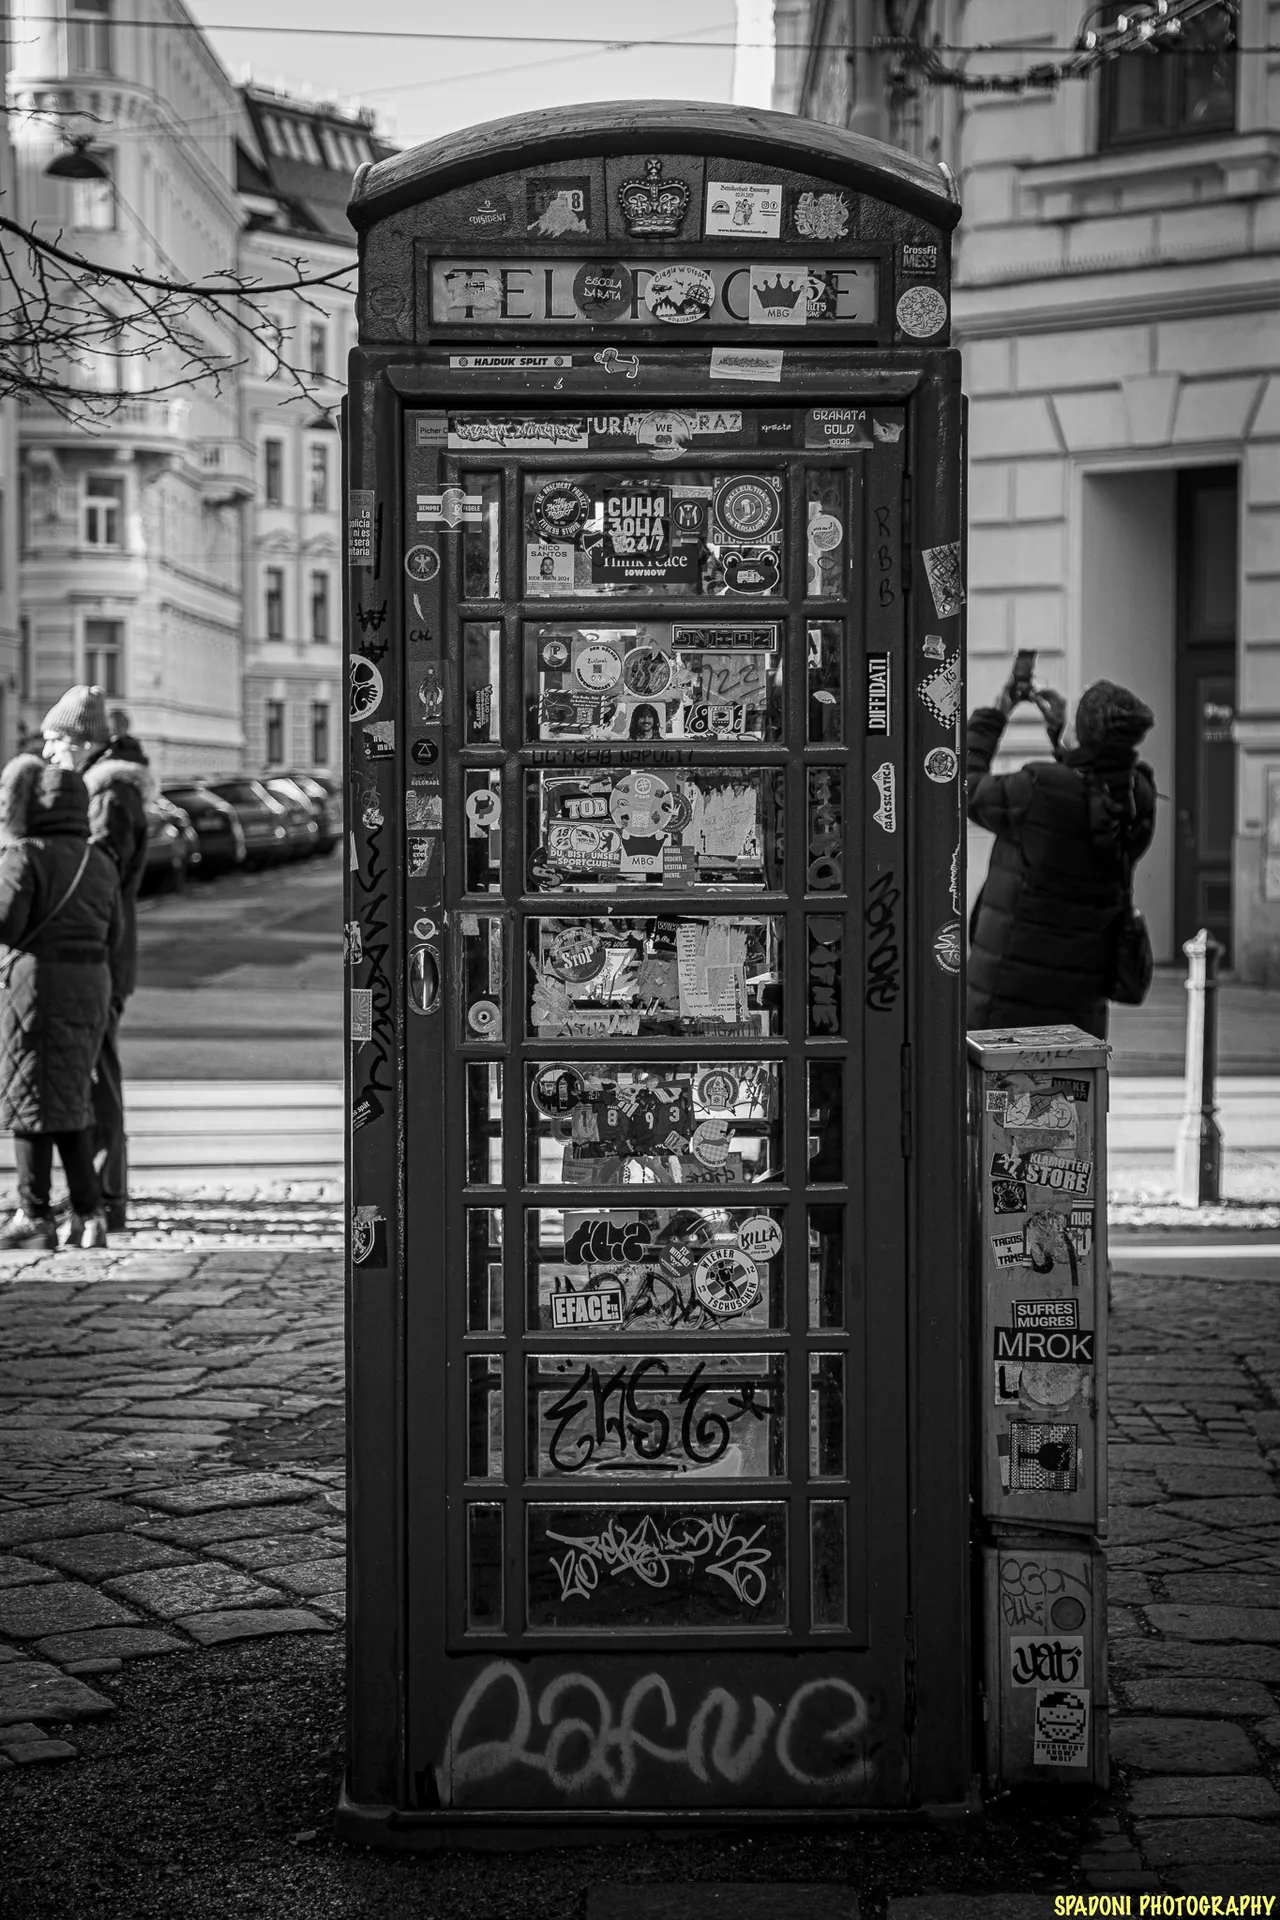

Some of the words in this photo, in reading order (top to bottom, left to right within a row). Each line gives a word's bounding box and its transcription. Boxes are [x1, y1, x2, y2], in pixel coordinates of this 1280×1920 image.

[903, 244, 937, 256] CrossFit
[903, 254, 937, 269] MES3
[767, 308, 790, 319] MBG
[474, 358, 515, 367] HAJDUK
[519, 357, 549, 366] SPLIT
[812, 410, 866, 421] GRANATA
[420, 427, 442, 435] Picher
[655, 423, 673, 433] WE
[823, 424, 855, 435] GOLD
[418, 504, 440, 512] SEMPRE
[608, 497, 665, 518] СИНЯ
[361, 509, 371, 519] La
[868, 658, 887, 729] DIFFIDATI
[568, 850, 586, 859] BIST
[591, 852, 620, 861] UNSER
[631, 857, 654, 866] MBG
[607, 1109, 619, 1127] 8
[645, 1112, 655, 1130] 9
[1026, 1164, 1088, 1193] STORE
[741, 1226, 779, 1248] KILLA
[700, 1249, 735, 1270] WIENER
[707, 1282, 757, 1311] TSCHUSCHEN
[555, 1294, 611, 1324] EFACE
[1017, 1303, 1073, 1316] SUFRES
[1017, 1317, 1075, 1328] MUGRES
[998, 1331, 1093, 1360] MROK
[1036, 1743, 1084, 1751] EVERYBODY
